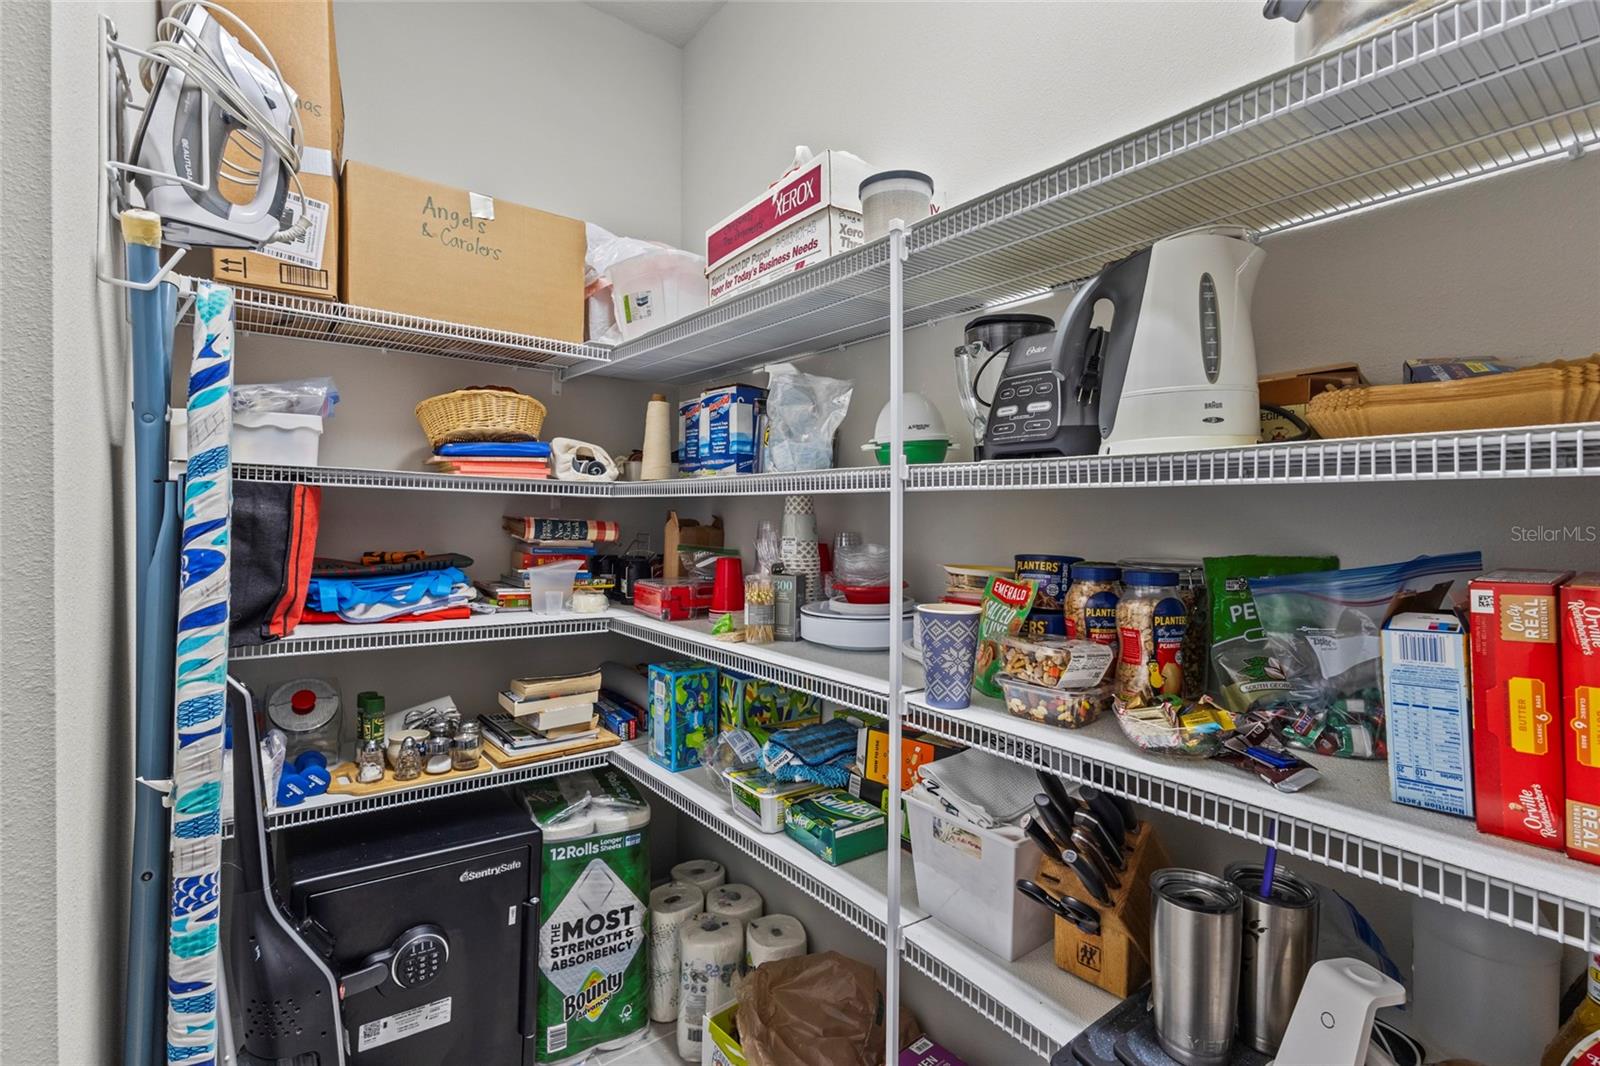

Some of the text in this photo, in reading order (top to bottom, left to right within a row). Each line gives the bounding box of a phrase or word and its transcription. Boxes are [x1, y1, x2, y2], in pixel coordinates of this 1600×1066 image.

[181, 137, 193, 181] BEAUTURA
[771, 177, 814, 219] XEROX
[422, 195, 486, 234] Angels
[421, 222, 502, 261] & Carolers
[839, 223, 863, 239] Xero
[725, 279, 733, 291] for
[733, 267, 757, 286] Today's
[758, 252, 791, 274] Business
[791, 238, 818, 258] Needs
[1204, 400, 1223, 409] BRAUN
[1017, 560, 1058, 573] PLANTERS
[993, 580, 1027, 601] EMERALD
[1085, 607, 1117, 618] PLANTE
[1154, 615, 1187, 626] PLANTER
[1506, 602, 1524, 632] Only
[1523, 598, 1540, 639] REAL
[1540, 598, 1549, 640] INGREDIENTS
[1518, 698, 1528, 732] BUTTER
[1536, 713, 1549, 722] 6
[1574, 720, 1588, 730] 6
[1536, 723, 1544, 745] CLASSIC
[1398, 796, 1465, 815] Nutrition Facts
[1519, 788, 1544, 831] Orville
[1531, 783, 1557, 839] Redenbacher's
[600, 836, 623, 846] Longer
[1582, 806, 1599, 849] REAL
[600, 843, 622, 852] Sheets
[551, 923, 561, 945] THE
[562, 904, 635, 943] MOST
[550, 927, 634, 959] STRENGTH &
[550, 938, 634, 972] ABSORBENCY
[564, 971, 623, 1021] Bounty
